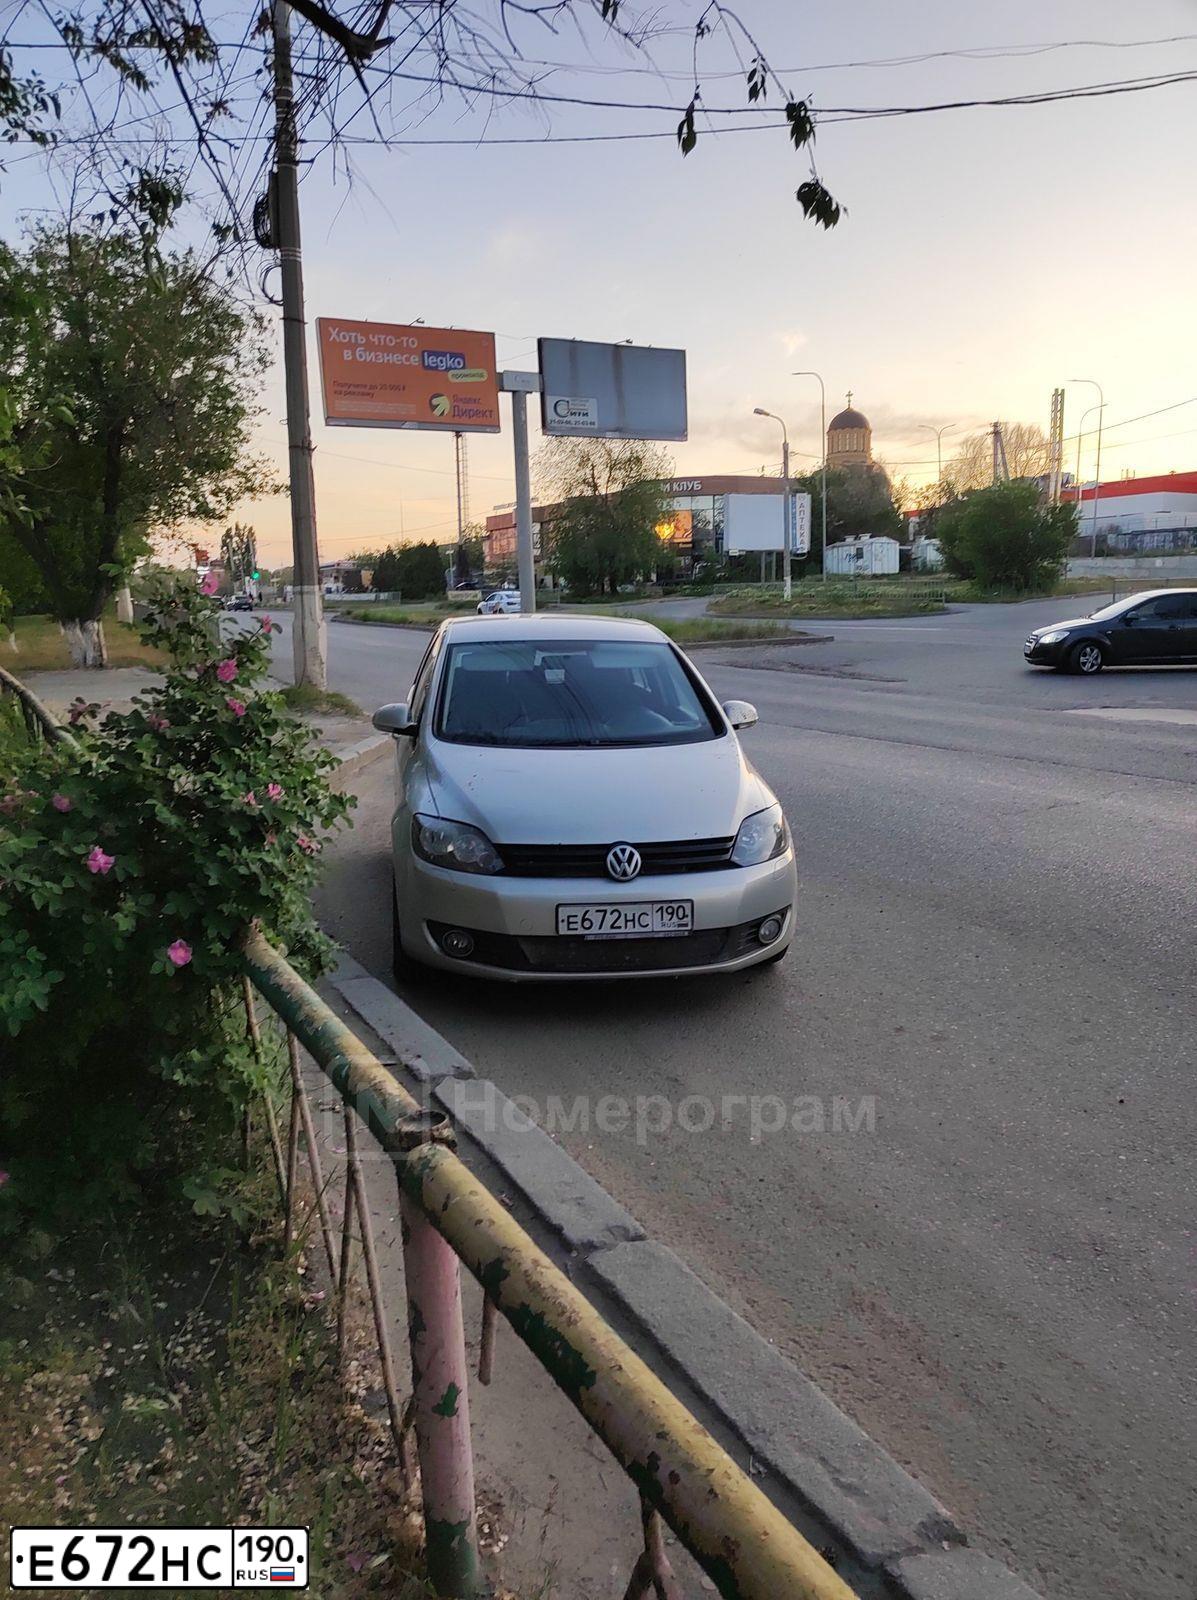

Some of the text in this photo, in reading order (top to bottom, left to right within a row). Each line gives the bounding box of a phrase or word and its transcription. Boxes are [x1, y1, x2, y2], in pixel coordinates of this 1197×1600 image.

[328, 326, 418, 348] Хоть что-то
[344, 347, 465, 370] в бизнесе legko
[452, 405, 494, 419] Директ
[672, 480, 702, 492] КЛУБ
[798, 502, 806, 545] АПТЕКА
[655, 904, 686, 921] 190
[660, 921, 677, 929] RUS
